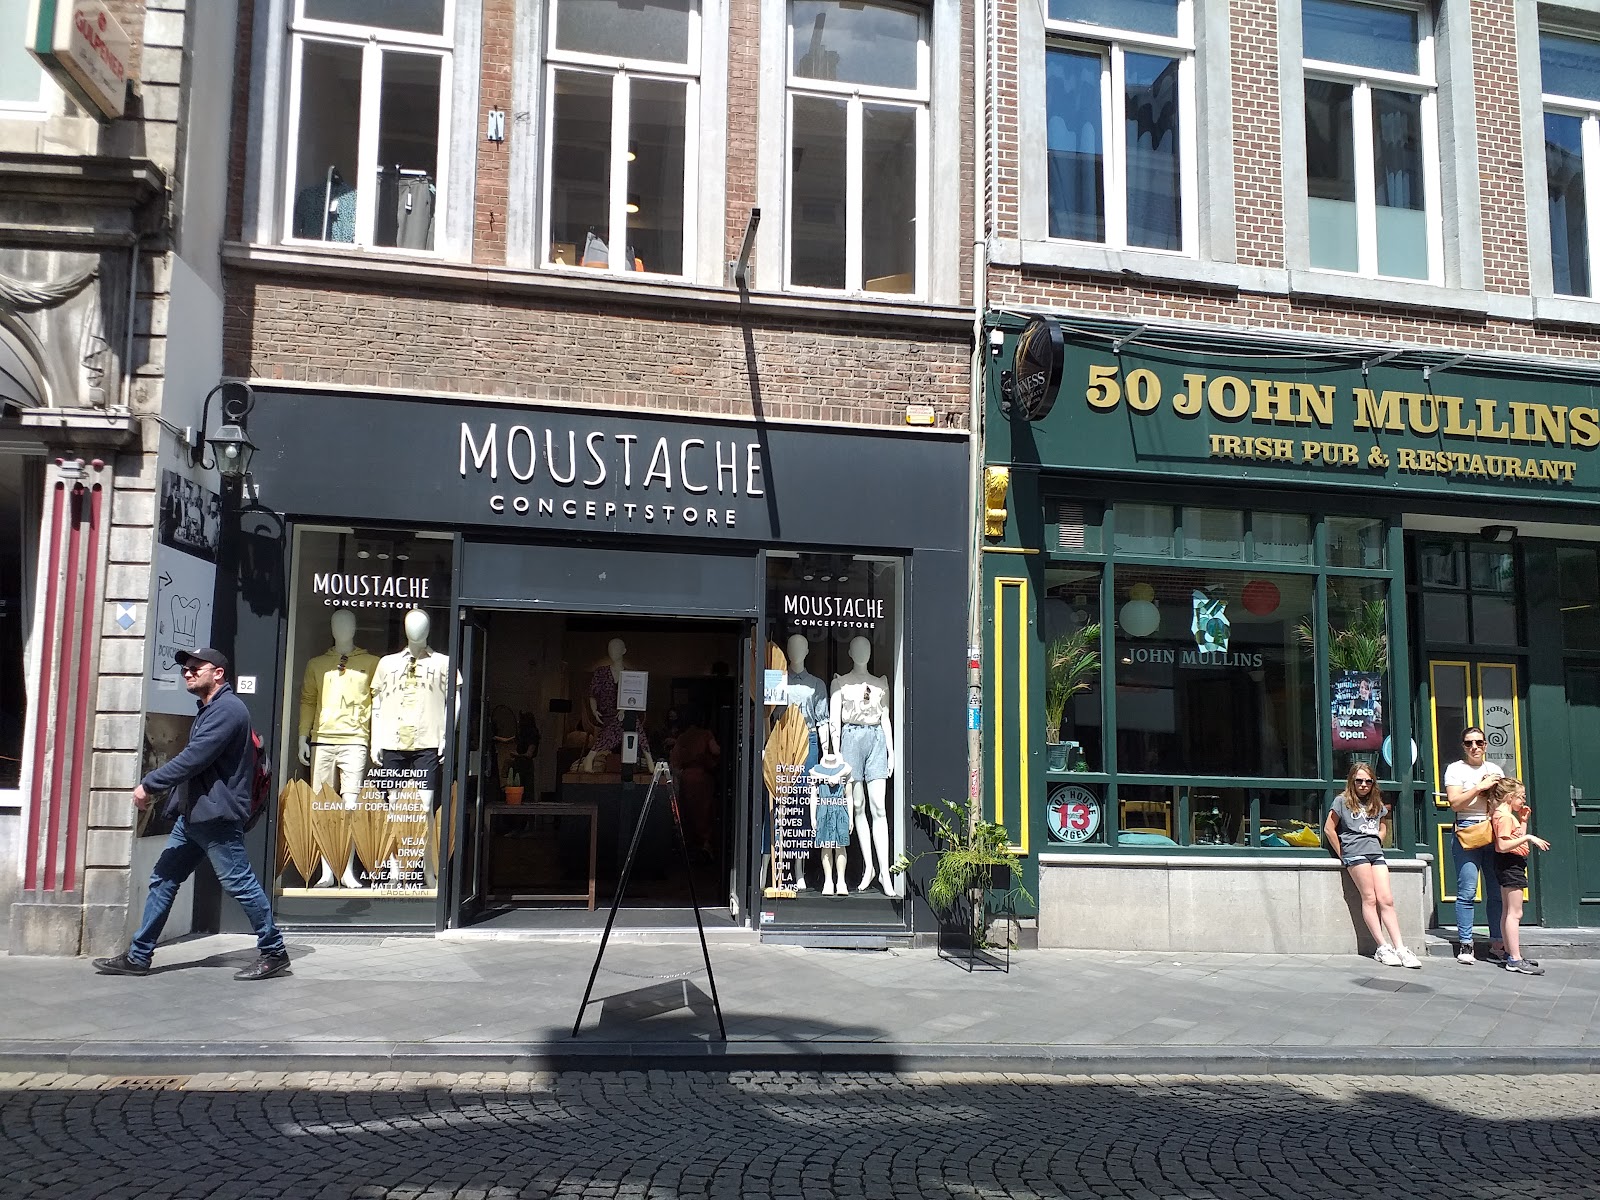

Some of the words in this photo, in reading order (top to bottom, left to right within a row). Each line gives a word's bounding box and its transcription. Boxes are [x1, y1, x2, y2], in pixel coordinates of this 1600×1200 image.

[1086, 364, 1162, 411] 50
[1172, 373, 1336, 425] JOHN
[1352, 387, 1600, 447] MULLINS
[459, 422, 764, 495] MOUSTACHE
[1209, 434, 1294, 462] IRISH
[1301, 441, 1360, 466] PUB
[1367, 446, 1390, 469] &
[1397, 448, 1577, 482] RESTAURANT
[489, 495, 736, 525] CONCEPTSTORE
[313, 573, 430, 599] MOUSTACHE
[324, 599, 419, 610] CONCEPTSTORE
[784, 594, 885, 618] MOUSTACHE
[794, 619, 875, 629] CONCEPTSTORE
[1129, 648, 1175, 665] JOHN
[1182, 650, 1263, 668] MULLINS
[240, 680, 253, 690] 52
[1339, 706, 1374, 717] Horeca
[1485, 705, 1511, 716] JOHN
[1339, 719, 1364, 728] weer
[1339, 731, 1367, 741] open.
[367, 768, 429, 778] ANERKJENDT
[356, 780, 394, 790] LECTED
[395, 780, 428, 790] HOMME
[776, 775, 817, 785] SELECTED
[819, 776, 847, 786] FEE
[362, 791, 387, 801] JUST
[775, 796, 799, 806] MSCH
[799, 797, 848, 807] COENHAGE
[312, 801, 342, 811] CLEAN
[1051, 793, 1066, 813] HOP
[1070, 790, 1096, 815] HOUSE
[386, 814, 427, 823] MINIMUM
[1058, 803, 1091, 830] 13
[775, 818, 803, 827] MOVES
[1057, 826, 1089, 839] LAGER
[401, 837, 425, 846] VEJA
[774, 840, 813, 849] ANOTHER
[814, 840, 840, 849] LABEL
[774, 850, 810, 859] MINIMUM
[406, 860, 425, 869] KIKI
